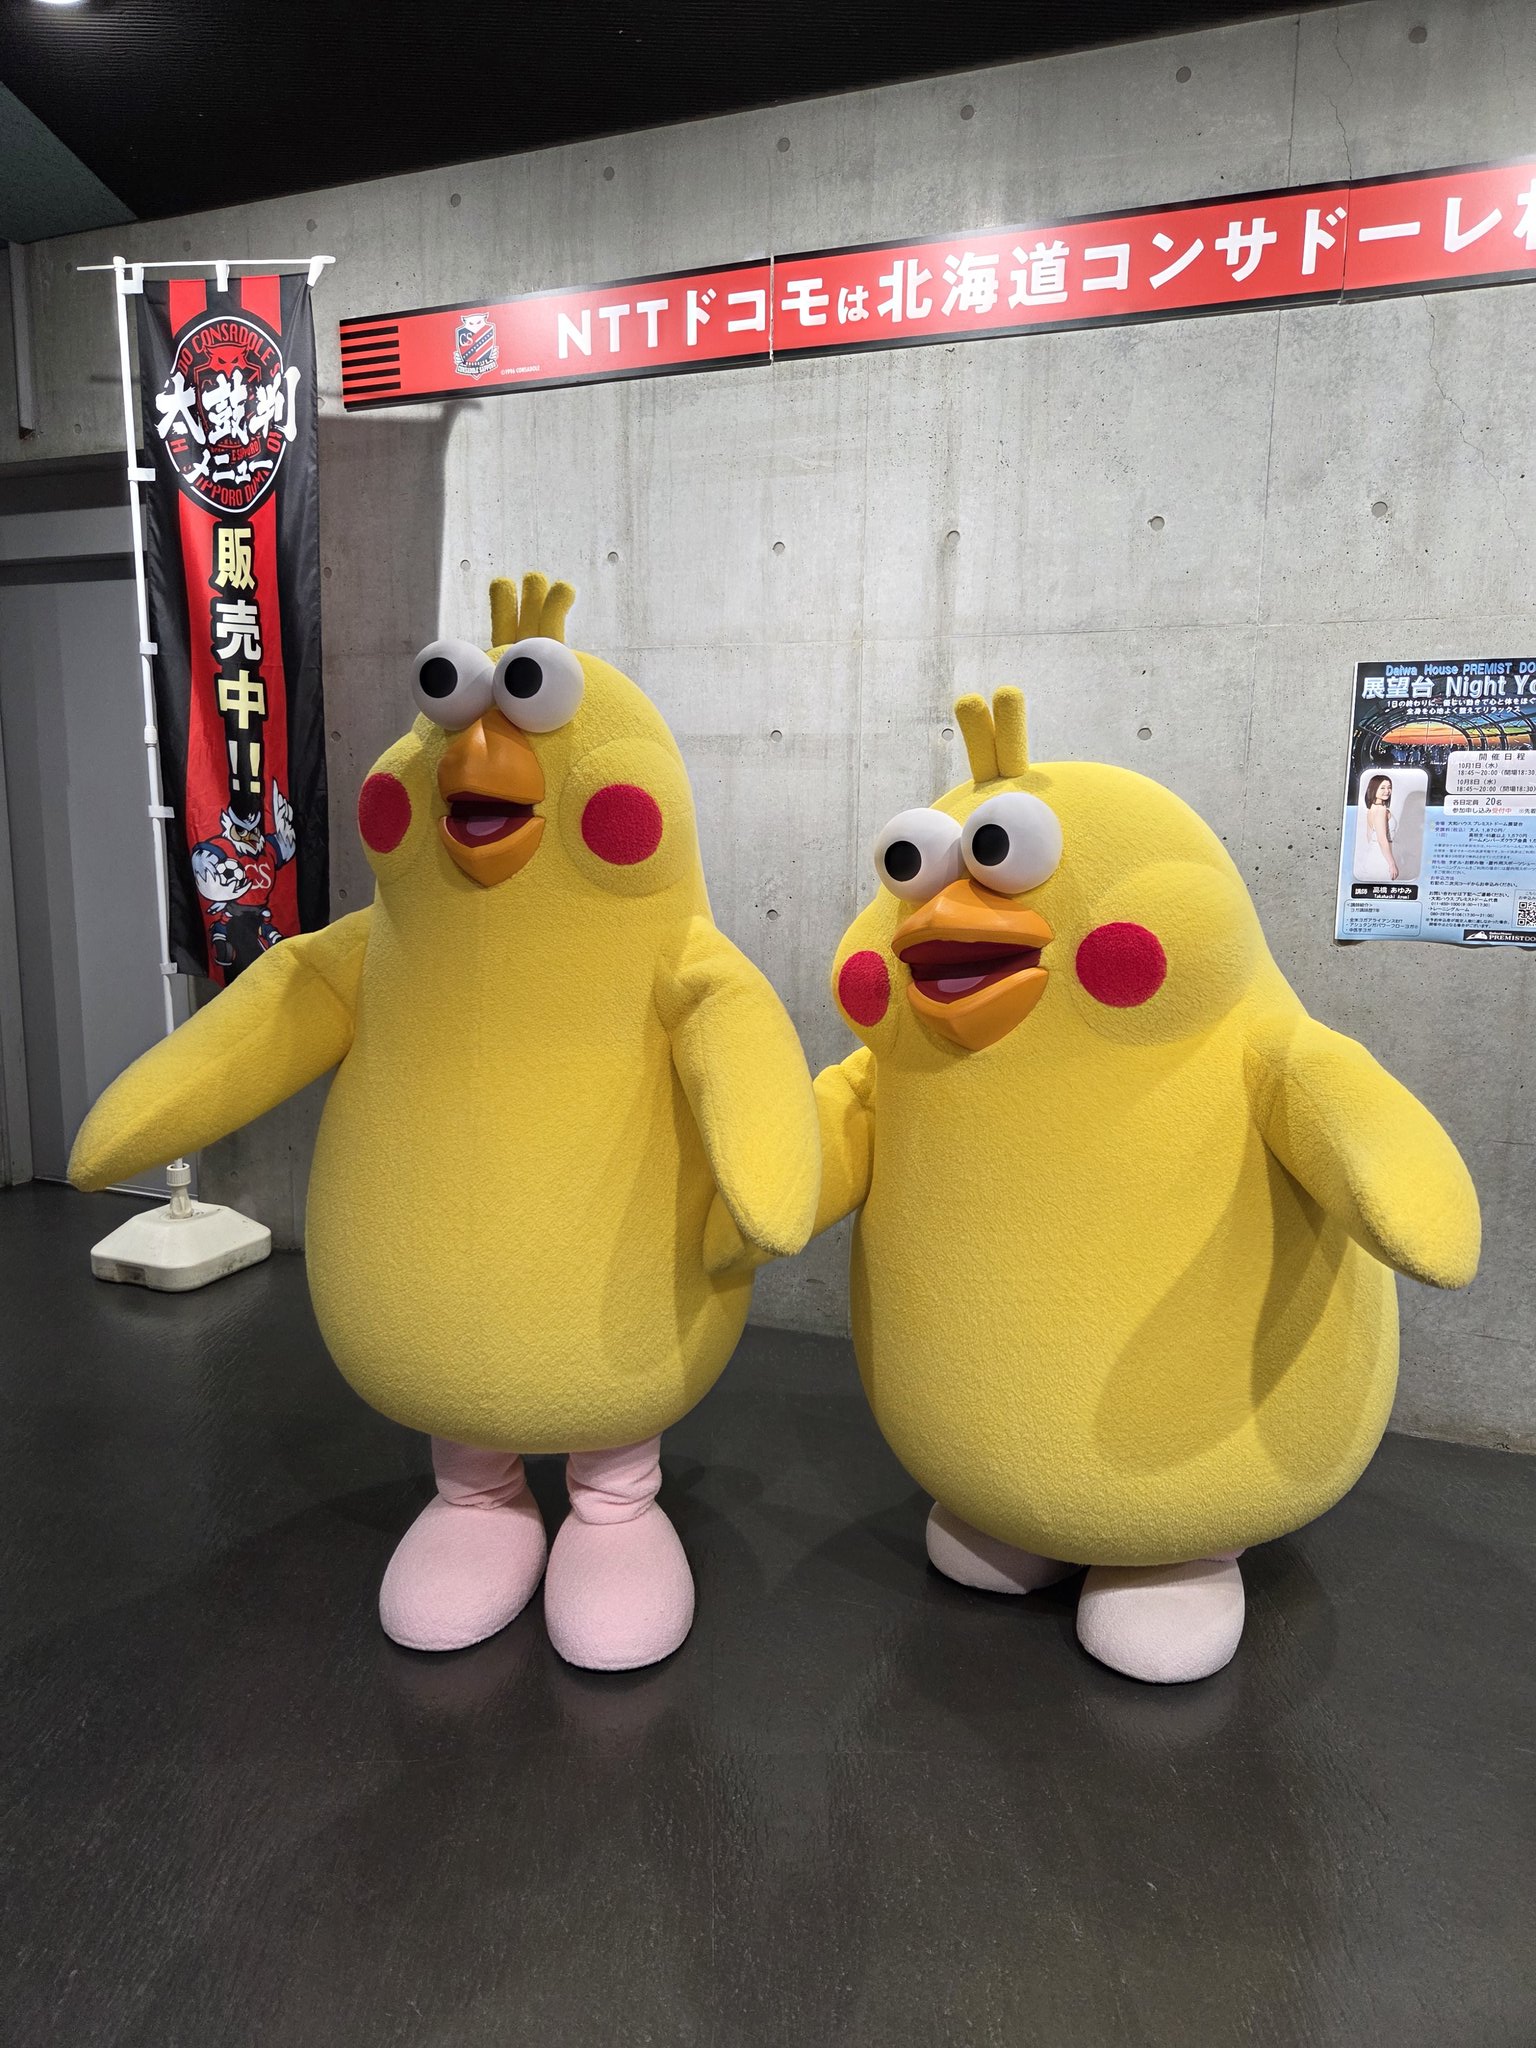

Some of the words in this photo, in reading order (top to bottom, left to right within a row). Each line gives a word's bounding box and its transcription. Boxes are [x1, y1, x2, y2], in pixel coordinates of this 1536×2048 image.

[214, 526, 267, 794] 販売中!!
[1386, 664, 1418, 677] Daiwa
[1424, 663, 1459, 676] House
[1462, 662, 1513, 675] PREMIST
[1361, 675, 1436, 700] 展望台
[1446, 675, 1507, 699] Night
[1488, 934, 1524, 942] PREMIST
